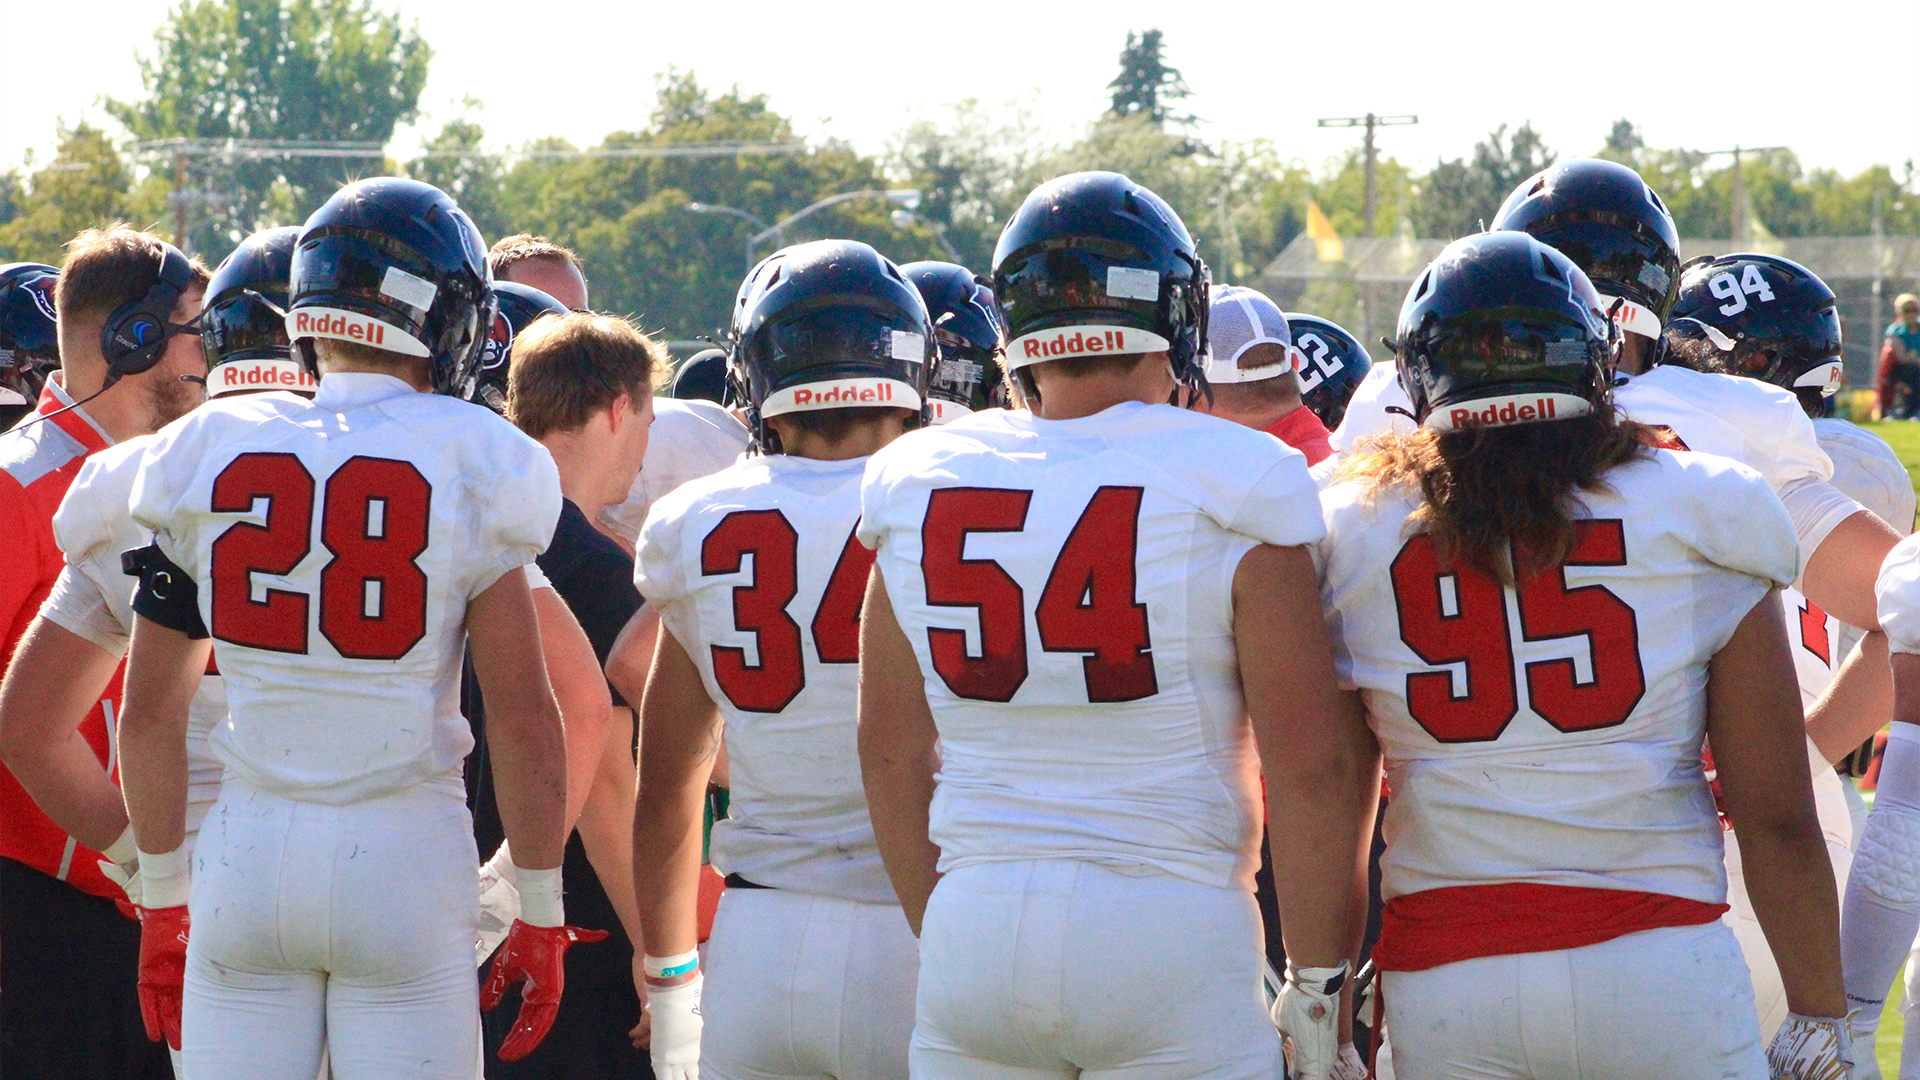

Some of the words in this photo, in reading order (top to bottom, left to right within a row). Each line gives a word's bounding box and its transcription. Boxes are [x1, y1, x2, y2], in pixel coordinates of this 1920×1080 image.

[1708, 264, 1776, 318] 94
[296, 312, 385, 346] Riddell
[1023, 331, 1125, 359] Riddell
[1290, 332, 1345, 395] 22
[794, 382, 893, 406] Riddell
[1450, 398, 1556, 430] Riddell
[210, 451, 433, 661] 28
[920, 485, 1160, 703] 54
[1389, 518, 1647, 744] 95
